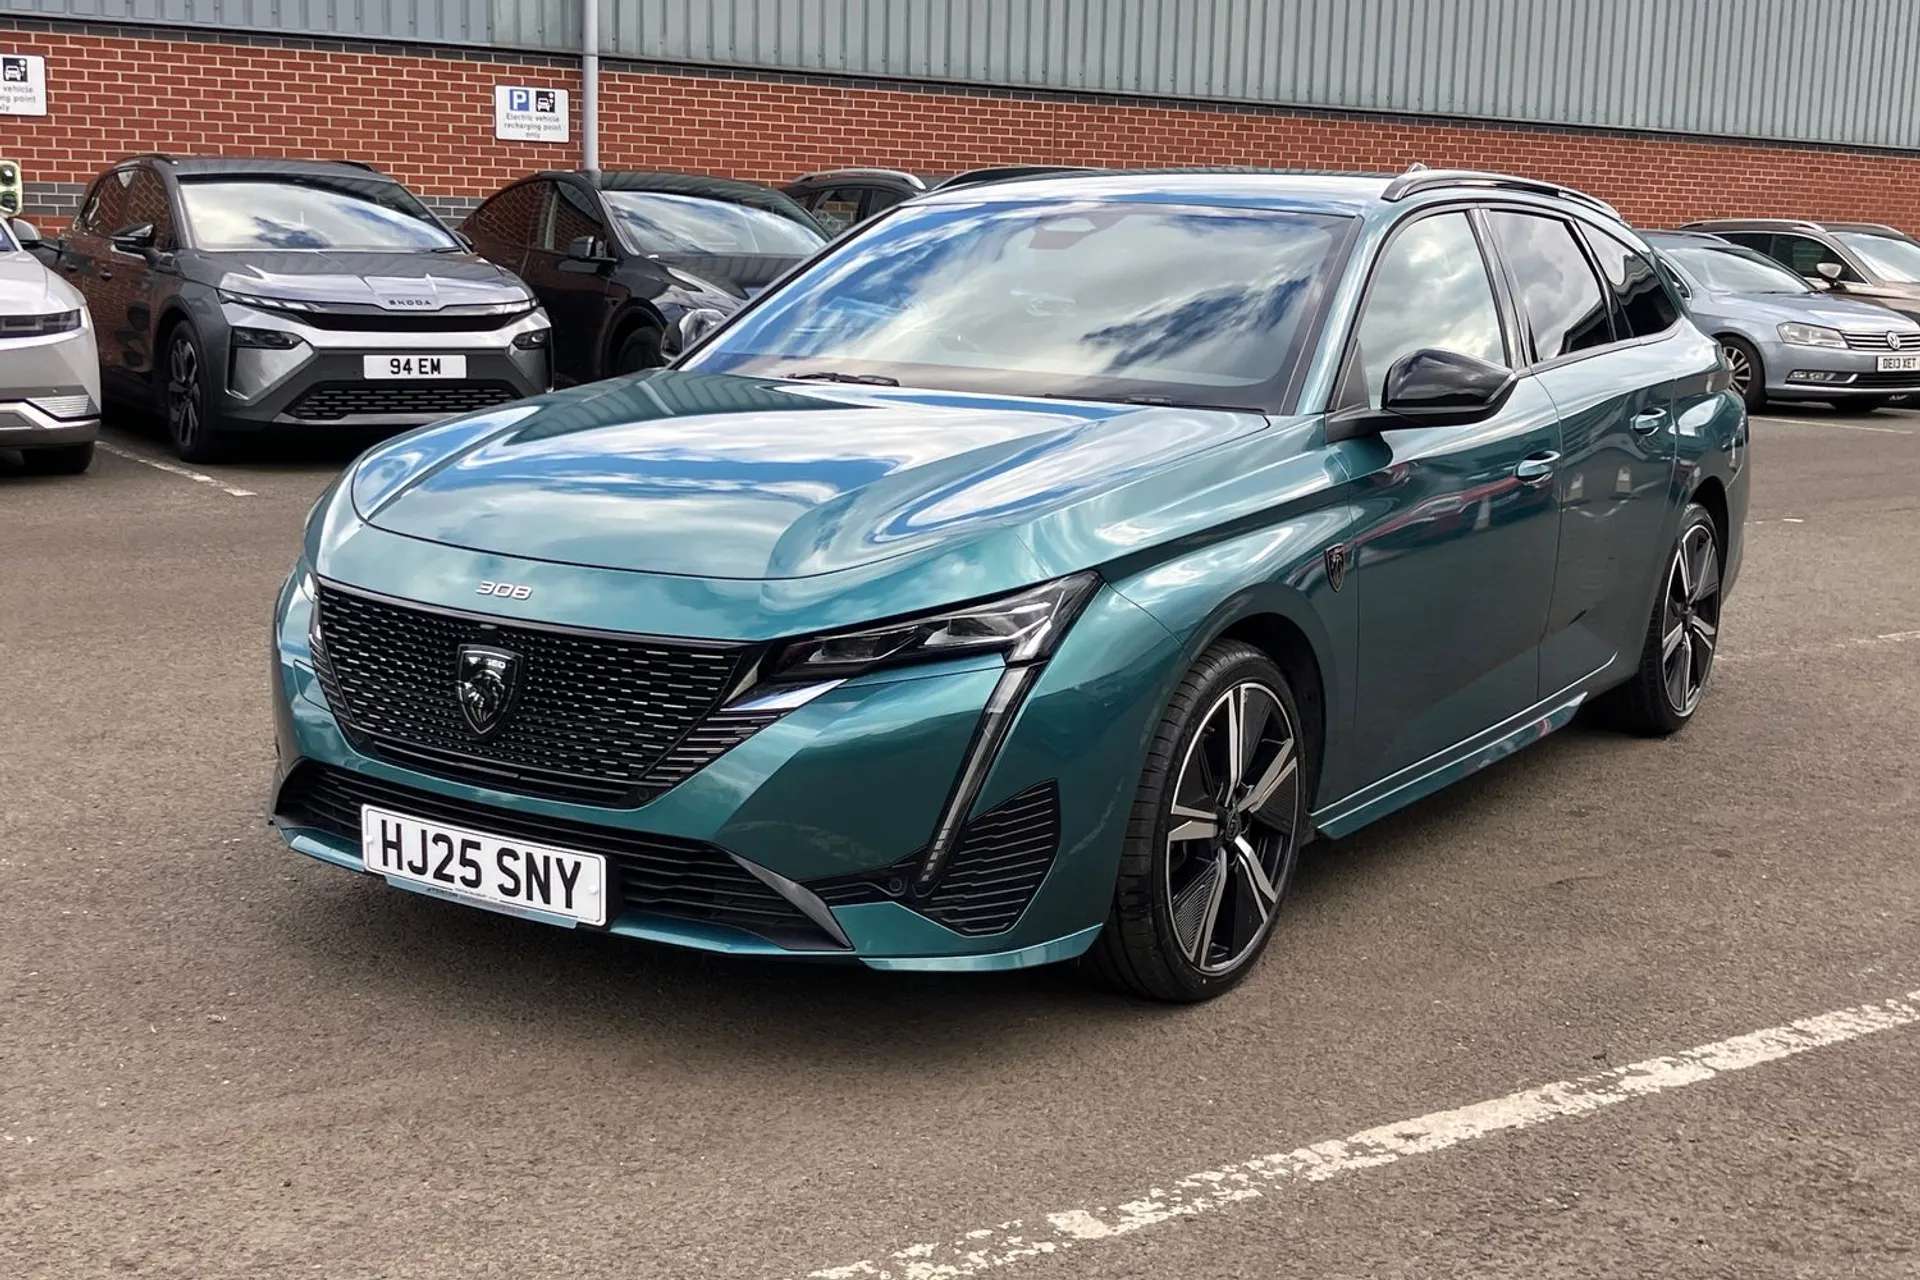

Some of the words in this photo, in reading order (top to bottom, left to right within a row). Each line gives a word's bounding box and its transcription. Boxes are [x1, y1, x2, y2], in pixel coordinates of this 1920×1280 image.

[513, 90, 528, 110] P
[504, 122, 542, 131] recharging
[506, 113, 533, 121] Electric
[535, 114, 560, 122] vehicle
[390, 358, 413, 375] 94
[418, 358, 442, 375] EM
[475, 580, 532, 600] 308
[381, 819, 482, 888] HJ25
[496, 847, 582, 909] SNY
